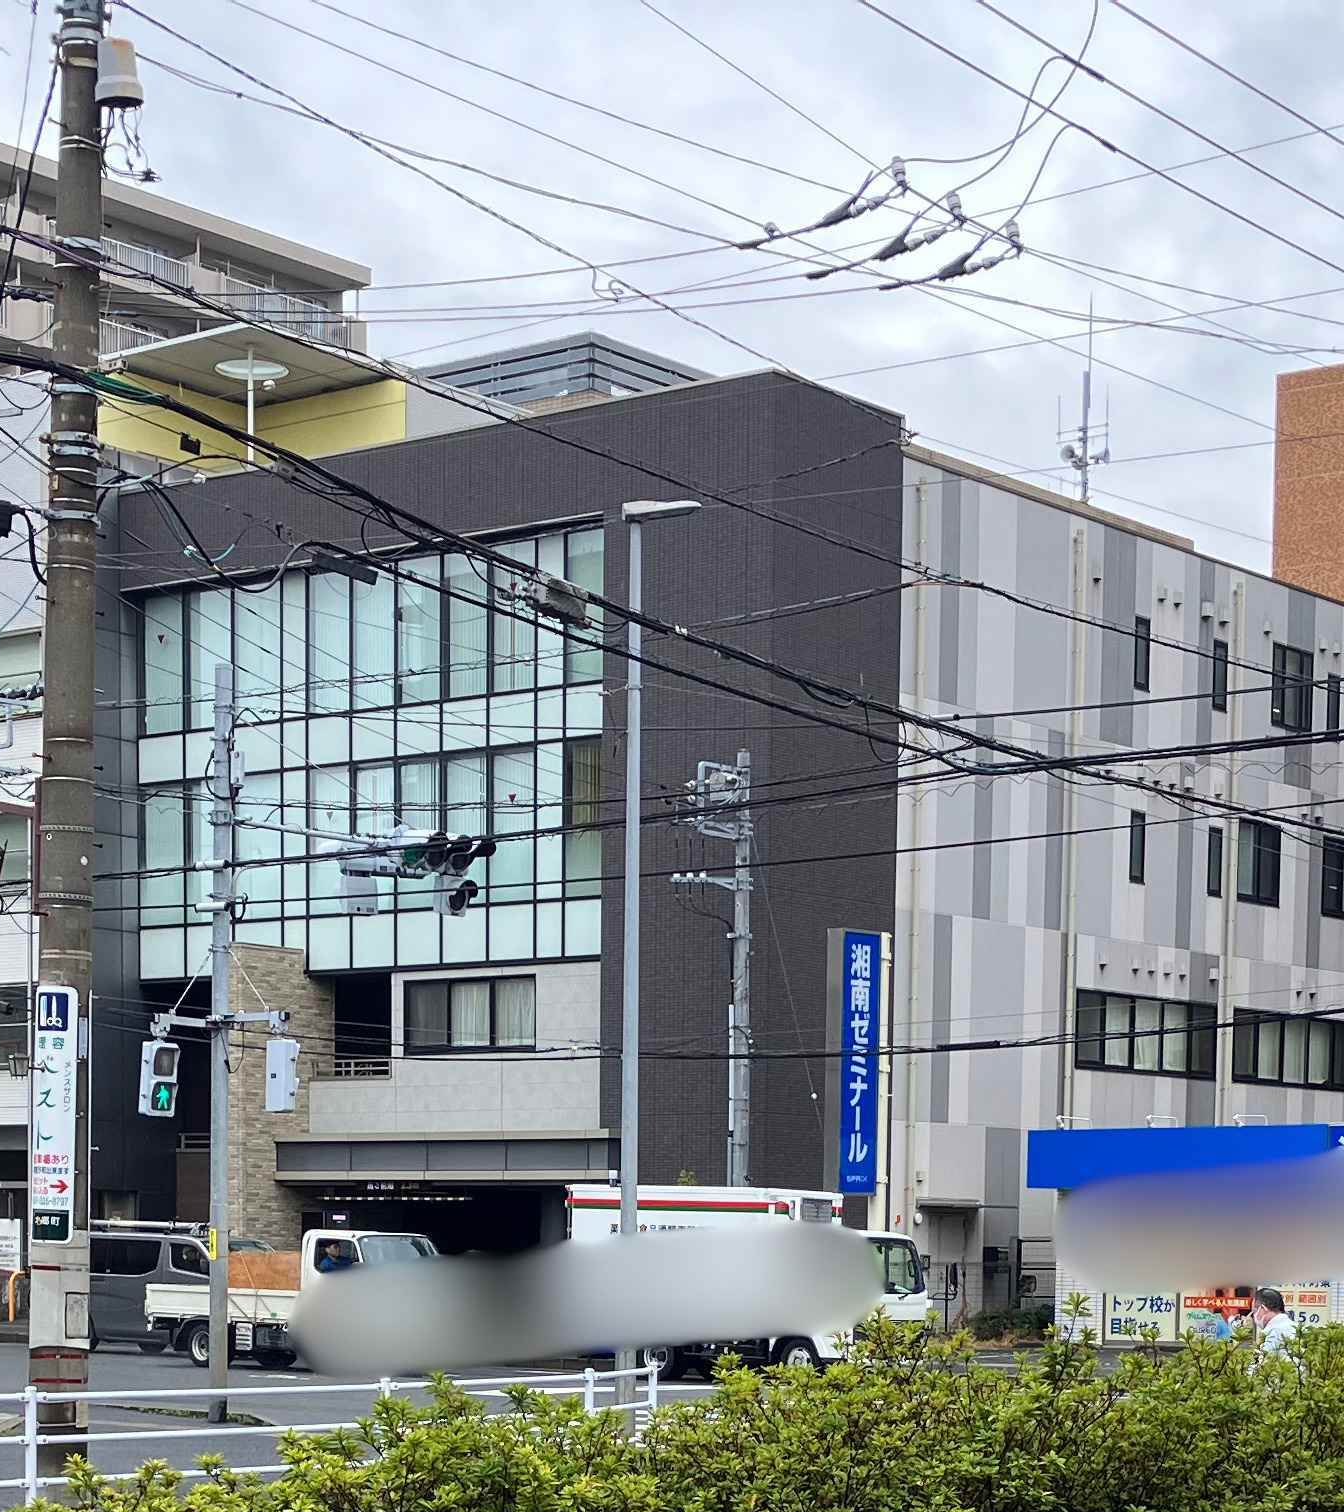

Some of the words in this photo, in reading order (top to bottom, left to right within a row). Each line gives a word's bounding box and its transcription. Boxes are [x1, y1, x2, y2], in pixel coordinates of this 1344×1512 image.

[847, 943, 872, 1164] 湘南ゼミナール
[1111, 1295, 1176, 1314] トップ校が
